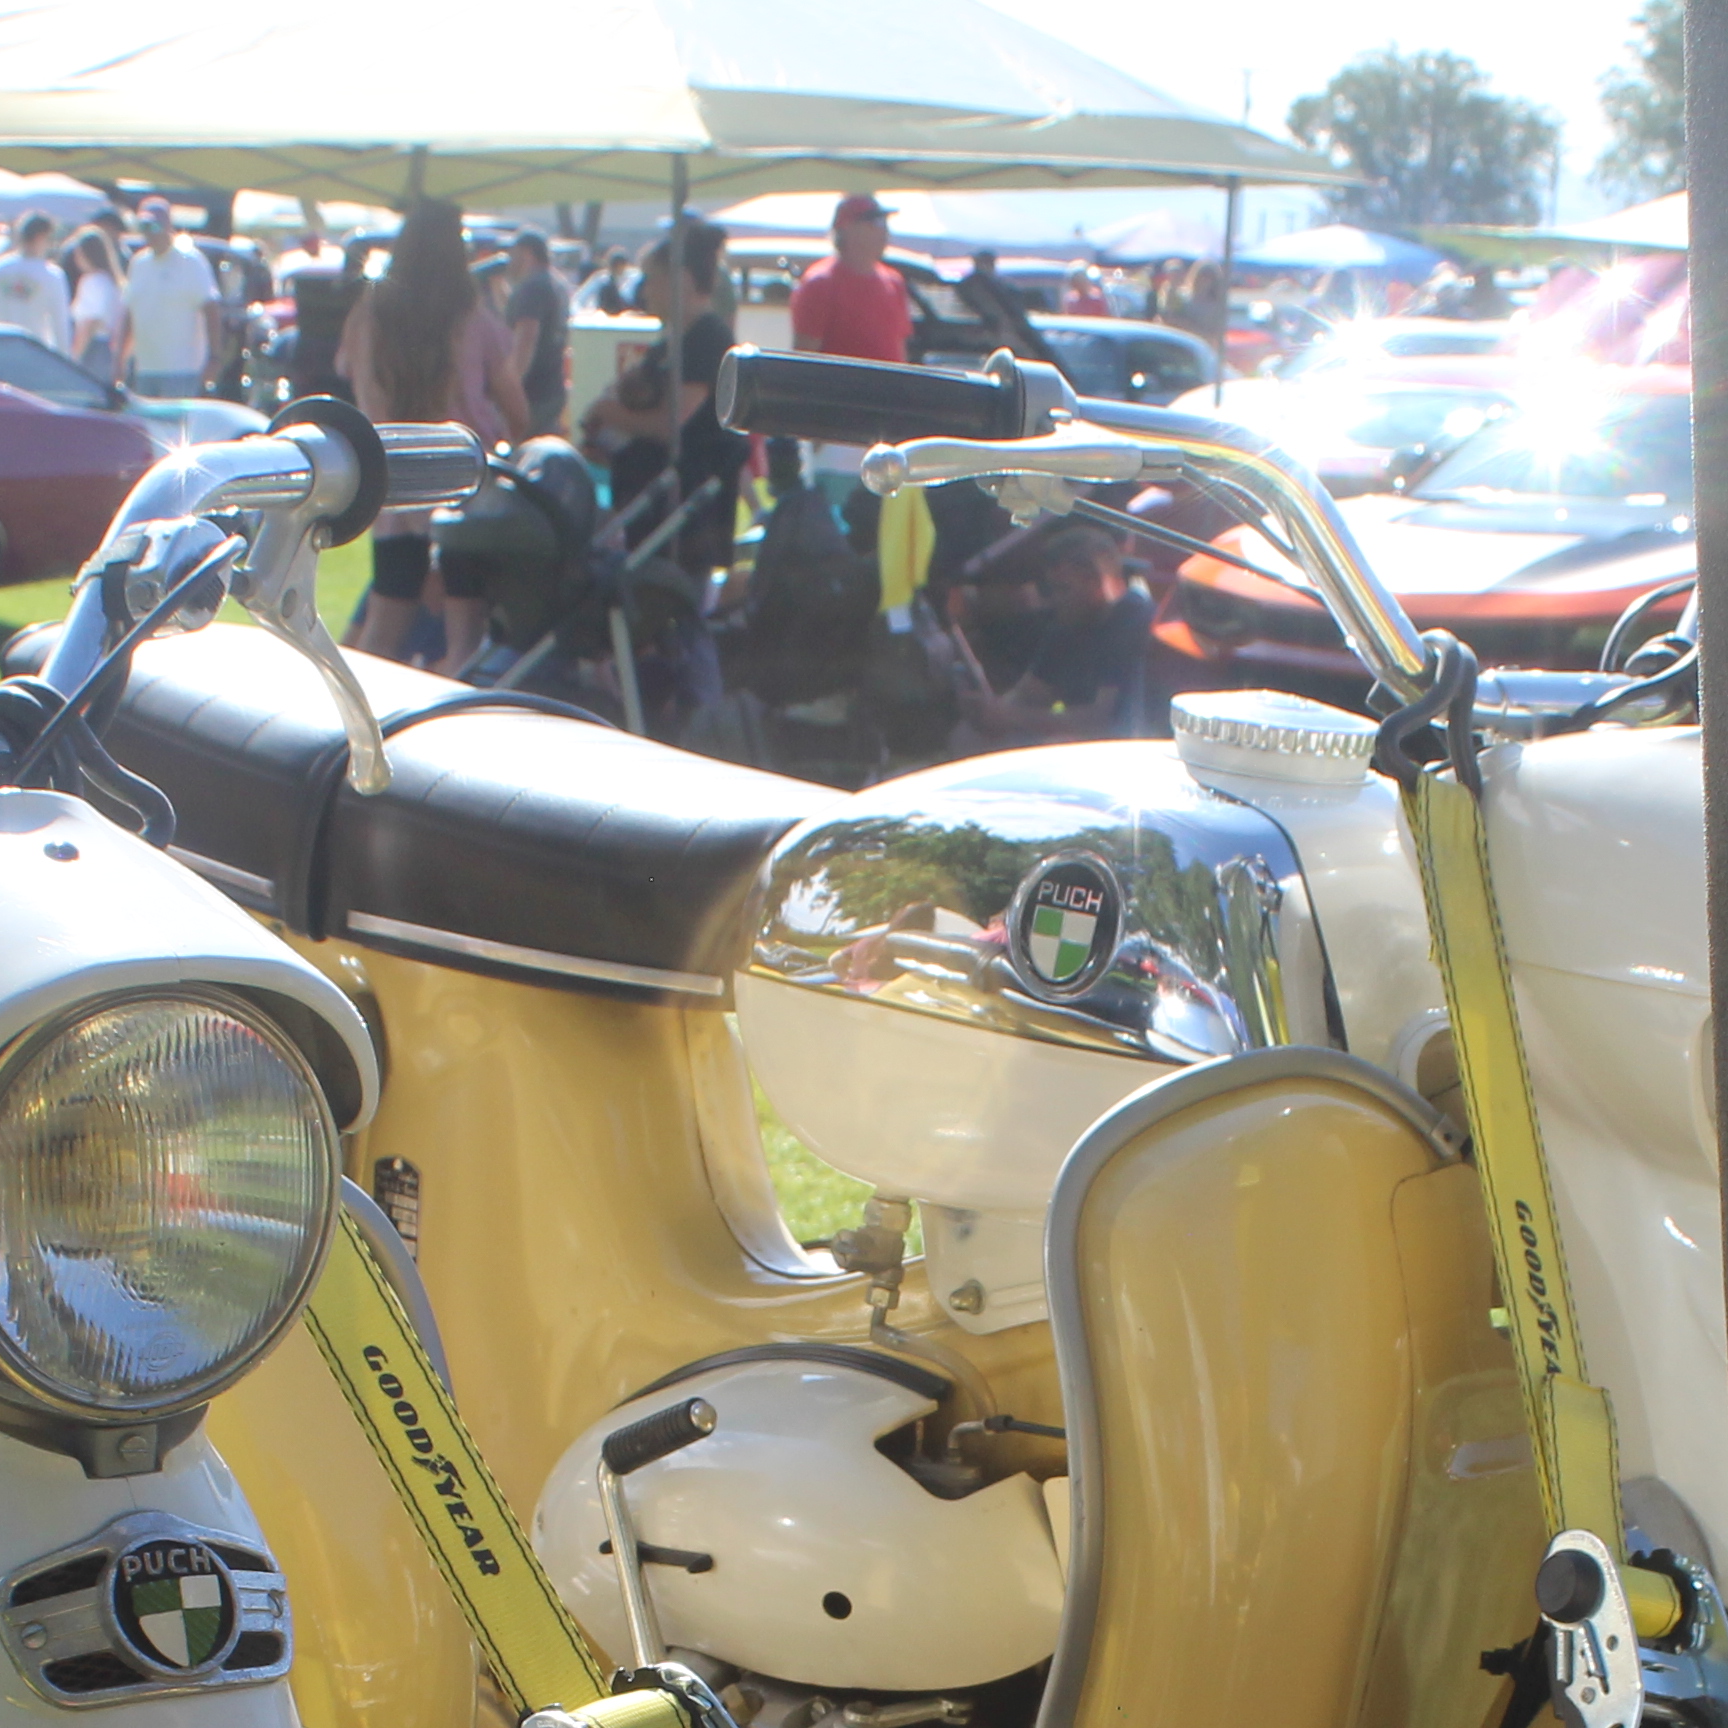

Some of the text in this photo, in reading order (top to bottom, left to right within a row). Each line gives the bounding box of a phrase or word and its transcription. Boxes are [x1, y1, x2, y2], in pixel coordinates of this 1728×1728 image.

[1037, 880, 1104, 914] PUCH
[1515, 1198, 1563, 1383] GOODYEA
[363, 1344, 501, 1577] GOODYEAR
[121, 1546, 213, 1583] PUCH
